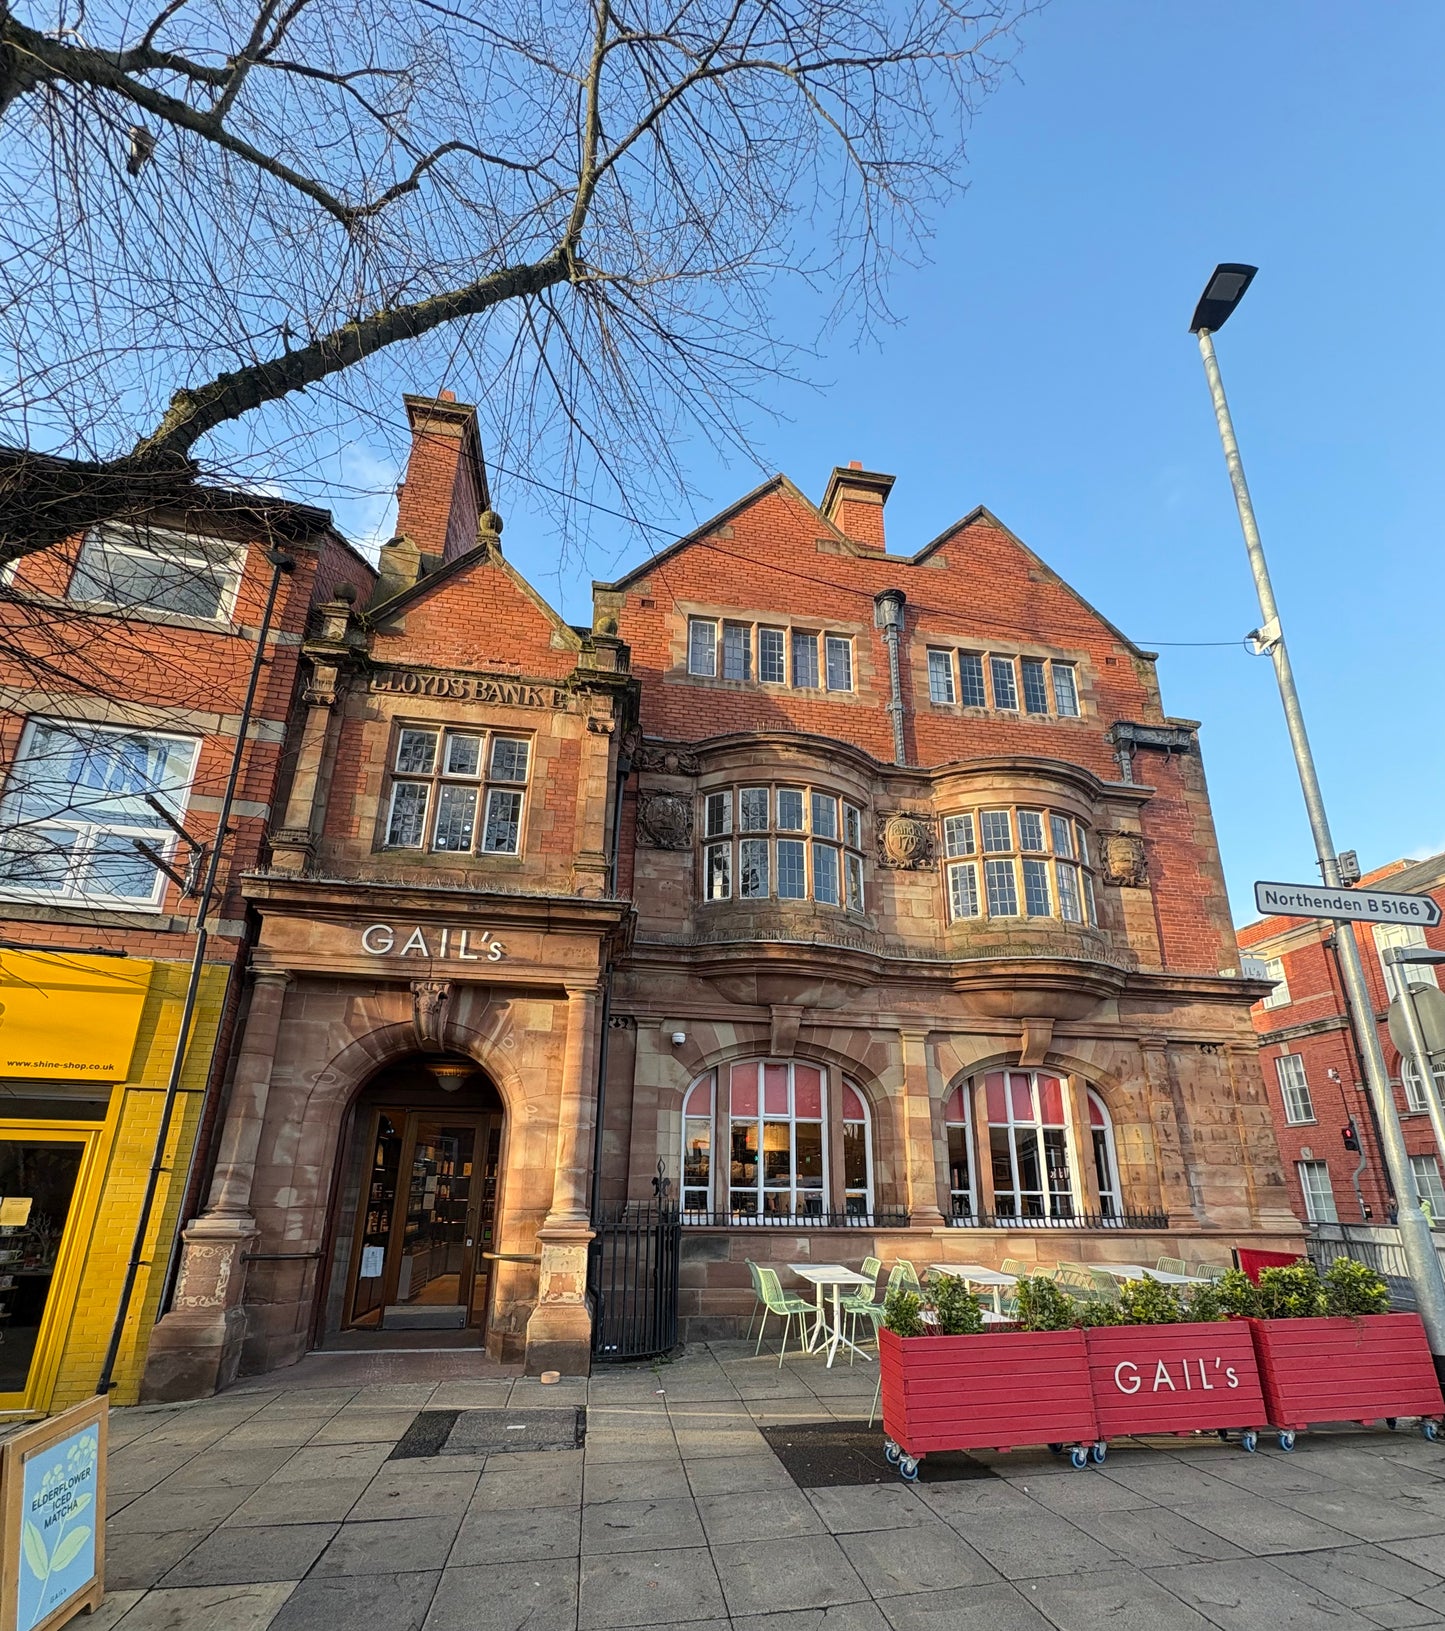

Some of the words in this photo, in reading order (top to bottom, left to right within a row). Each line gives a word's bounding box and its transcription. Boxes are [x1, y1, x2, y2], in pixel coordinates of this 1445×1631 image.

[370, 671, 465, 698] LLOYDS
[474, 680, 544, 707] BANK
[1265, 891, 1362, 912] Northenden
[361, 924, 502, 961] GAIL's
[7, 1060, 115, 1071] www.shine-shop.co.uk
[1114, 1357, 1239, 1394] GAIL's
[31, 1467, 91, 1512] ELDERFLOWER
[52, 1492, 72, 1511] ICED
[44, 1500, 78, 1529] MATCHA
